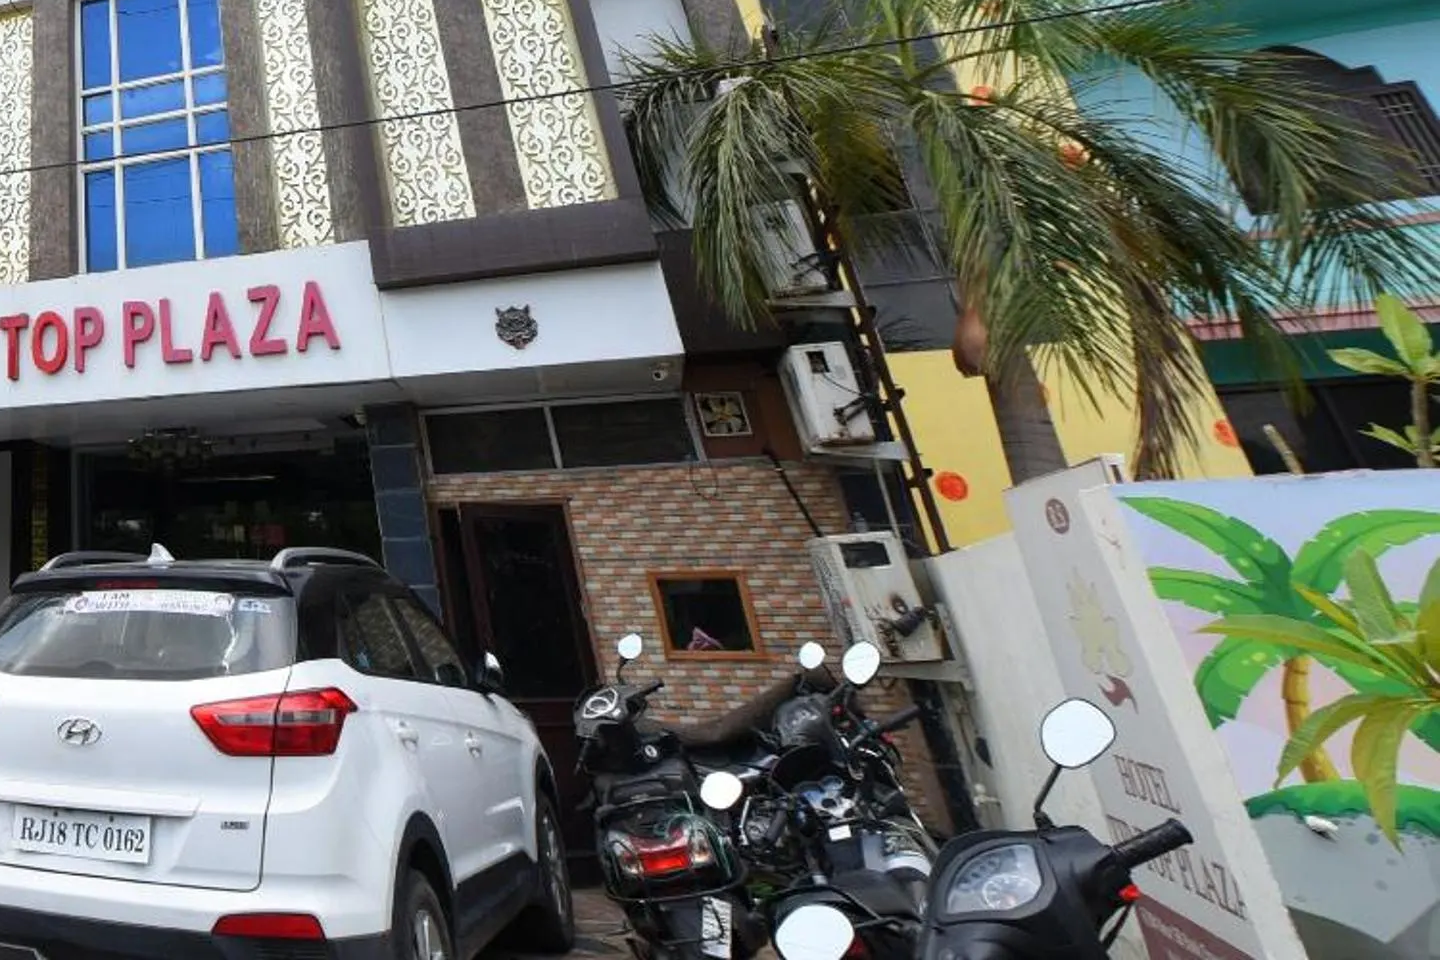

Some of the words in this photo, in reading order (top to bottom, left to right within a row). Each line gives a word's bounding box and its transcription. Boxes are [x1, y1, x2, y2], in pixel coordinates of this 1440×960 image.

[122, 281, 341, 368] PLAZA
[1113, 754, 1182, 815] HOTEL
[20, 817, 68, 846] RJ18
[72, 822, 99, 849] TC
[103, 826, 145, 852] 0162
